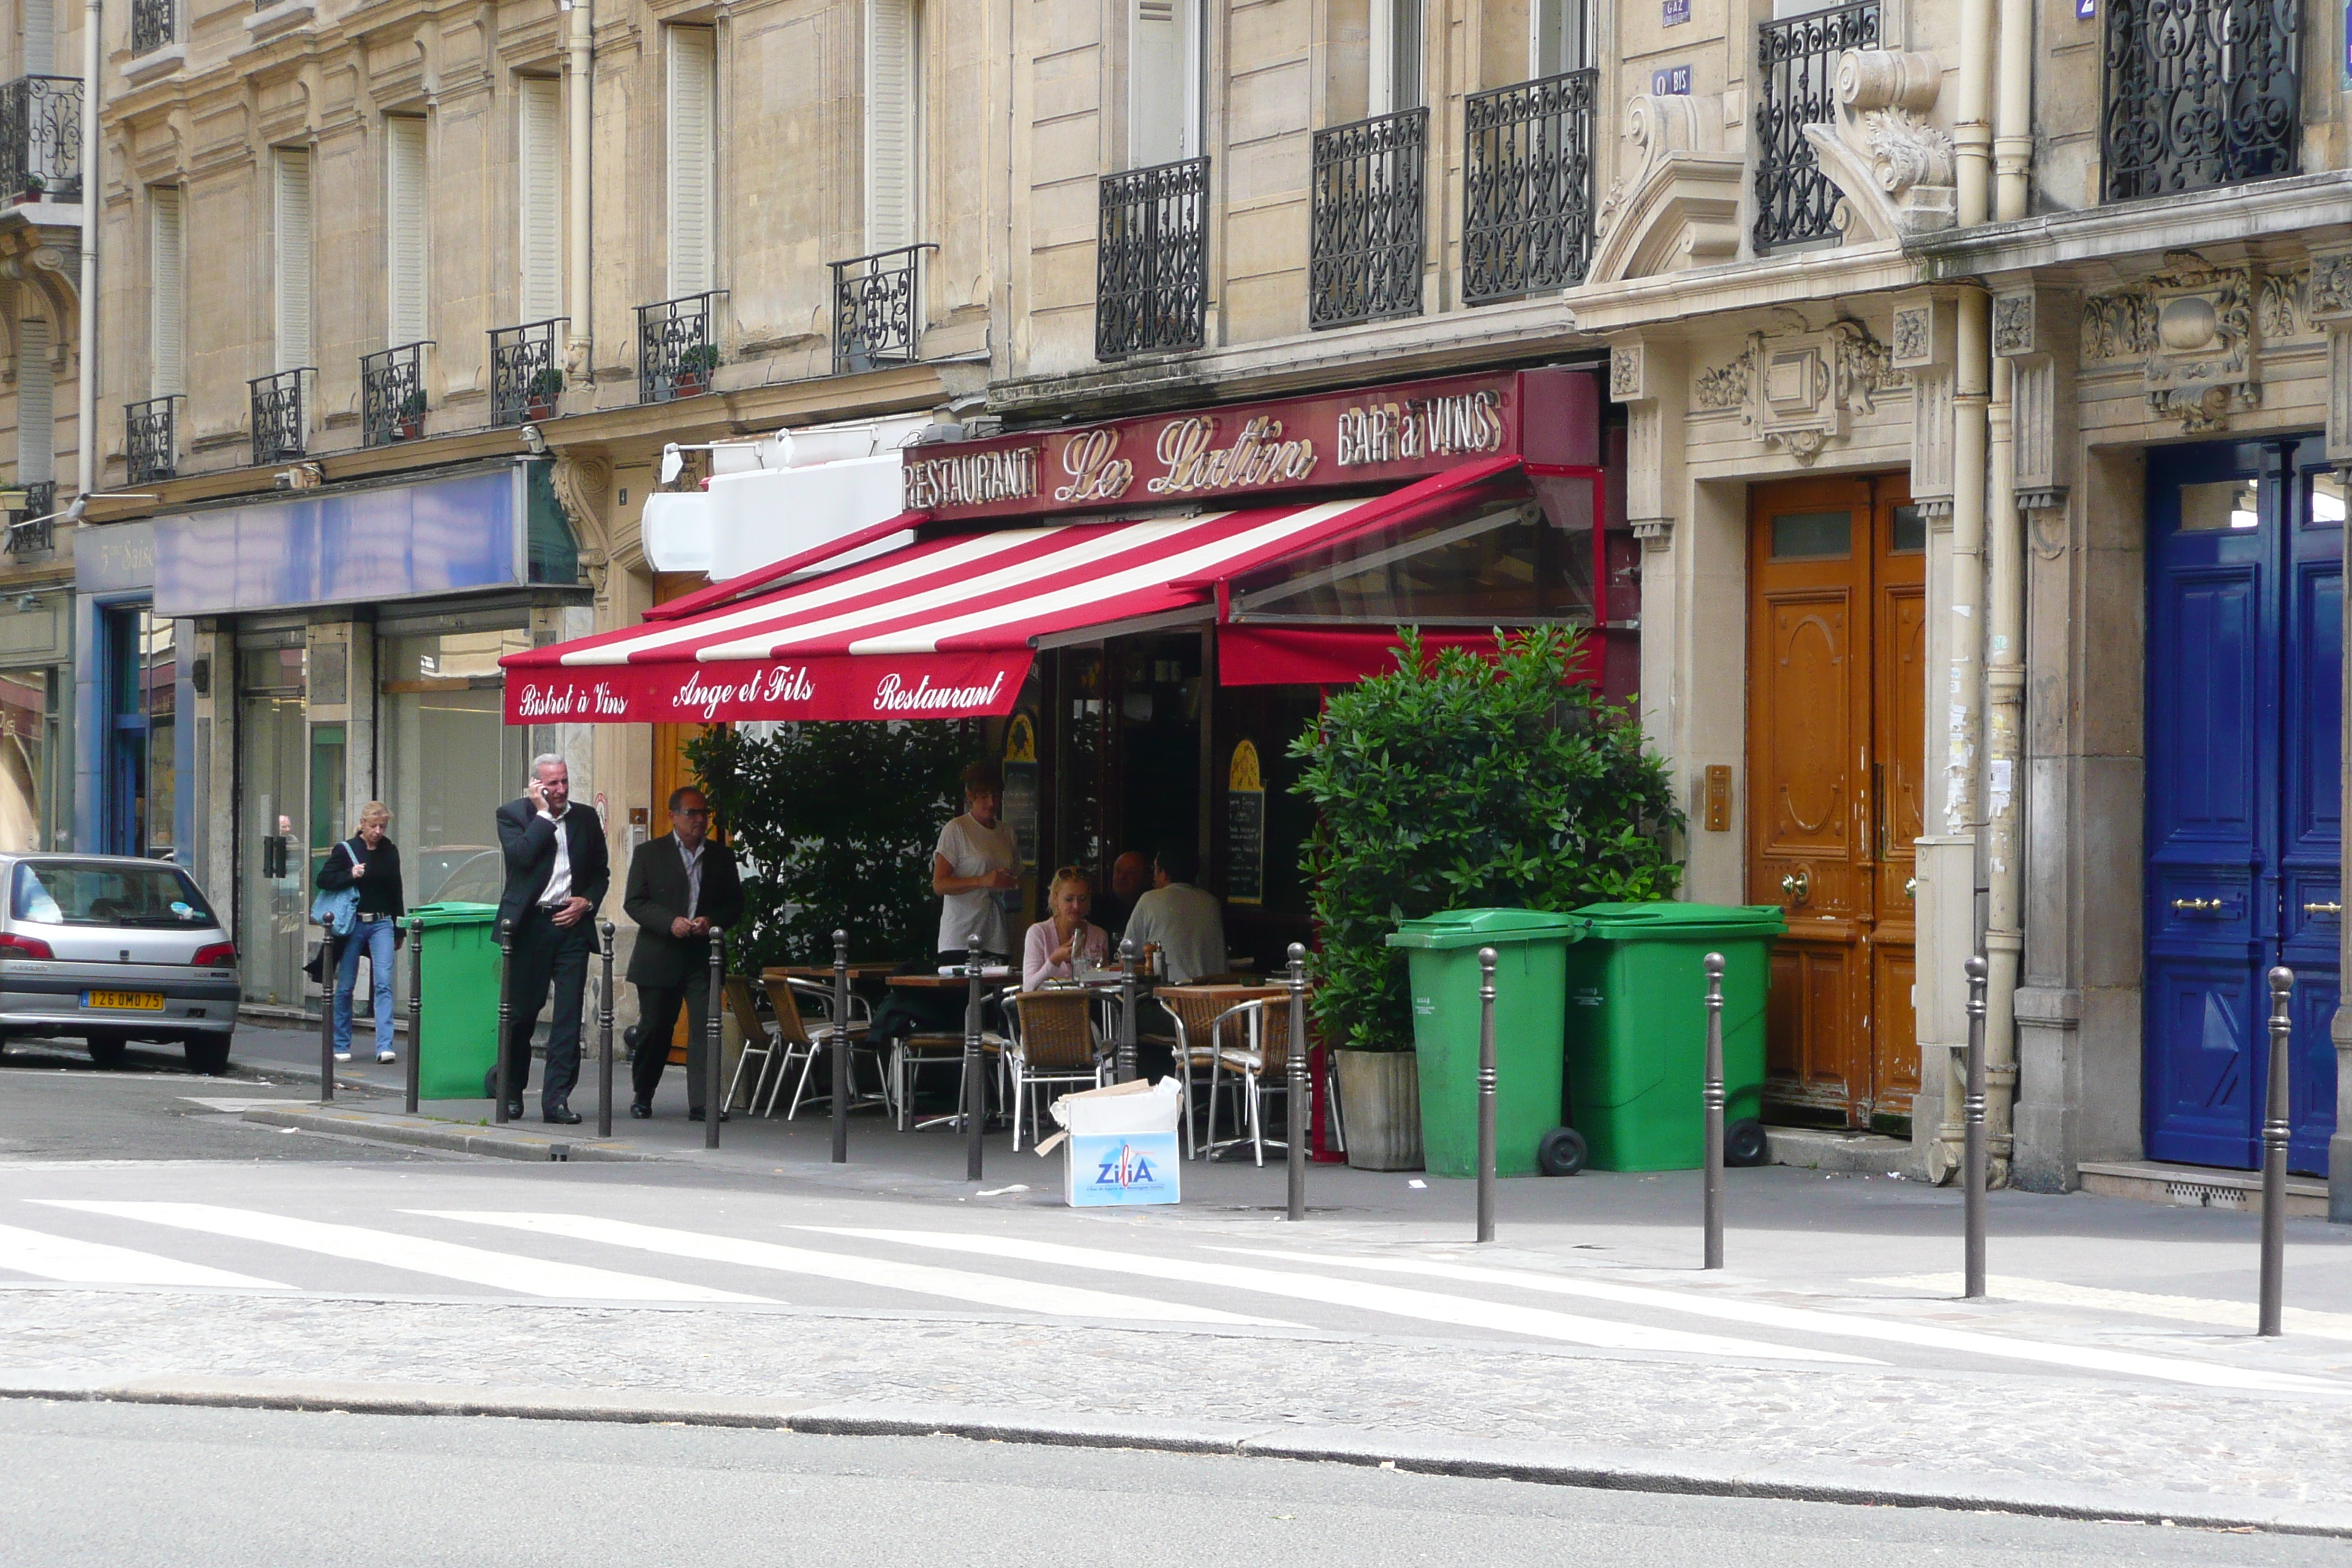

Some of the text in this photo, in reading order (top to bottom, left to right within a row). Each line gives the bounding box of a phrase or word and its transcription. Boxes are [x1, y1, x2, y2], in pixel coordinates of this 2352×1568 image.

[1667, 0, 1683, 14] GAZ
[1673, 69, 1686, 92] BIS
[1338, 403, 1400, 466] BAR
[1426, 390, 1501, 455] VINS
[901, 446, 1039, 510] RESTAURANT
[1055, 415, 1318, 503] Le Lutin
[519, 681, 628, 717] Bistrot à Vins
[672, 665, 816, 720] Ange et Fils
[873, 671, 1006, 711] Restaurant
[91, 992, 114, 1006] 126
[146, 995, 159, 1008] 75
